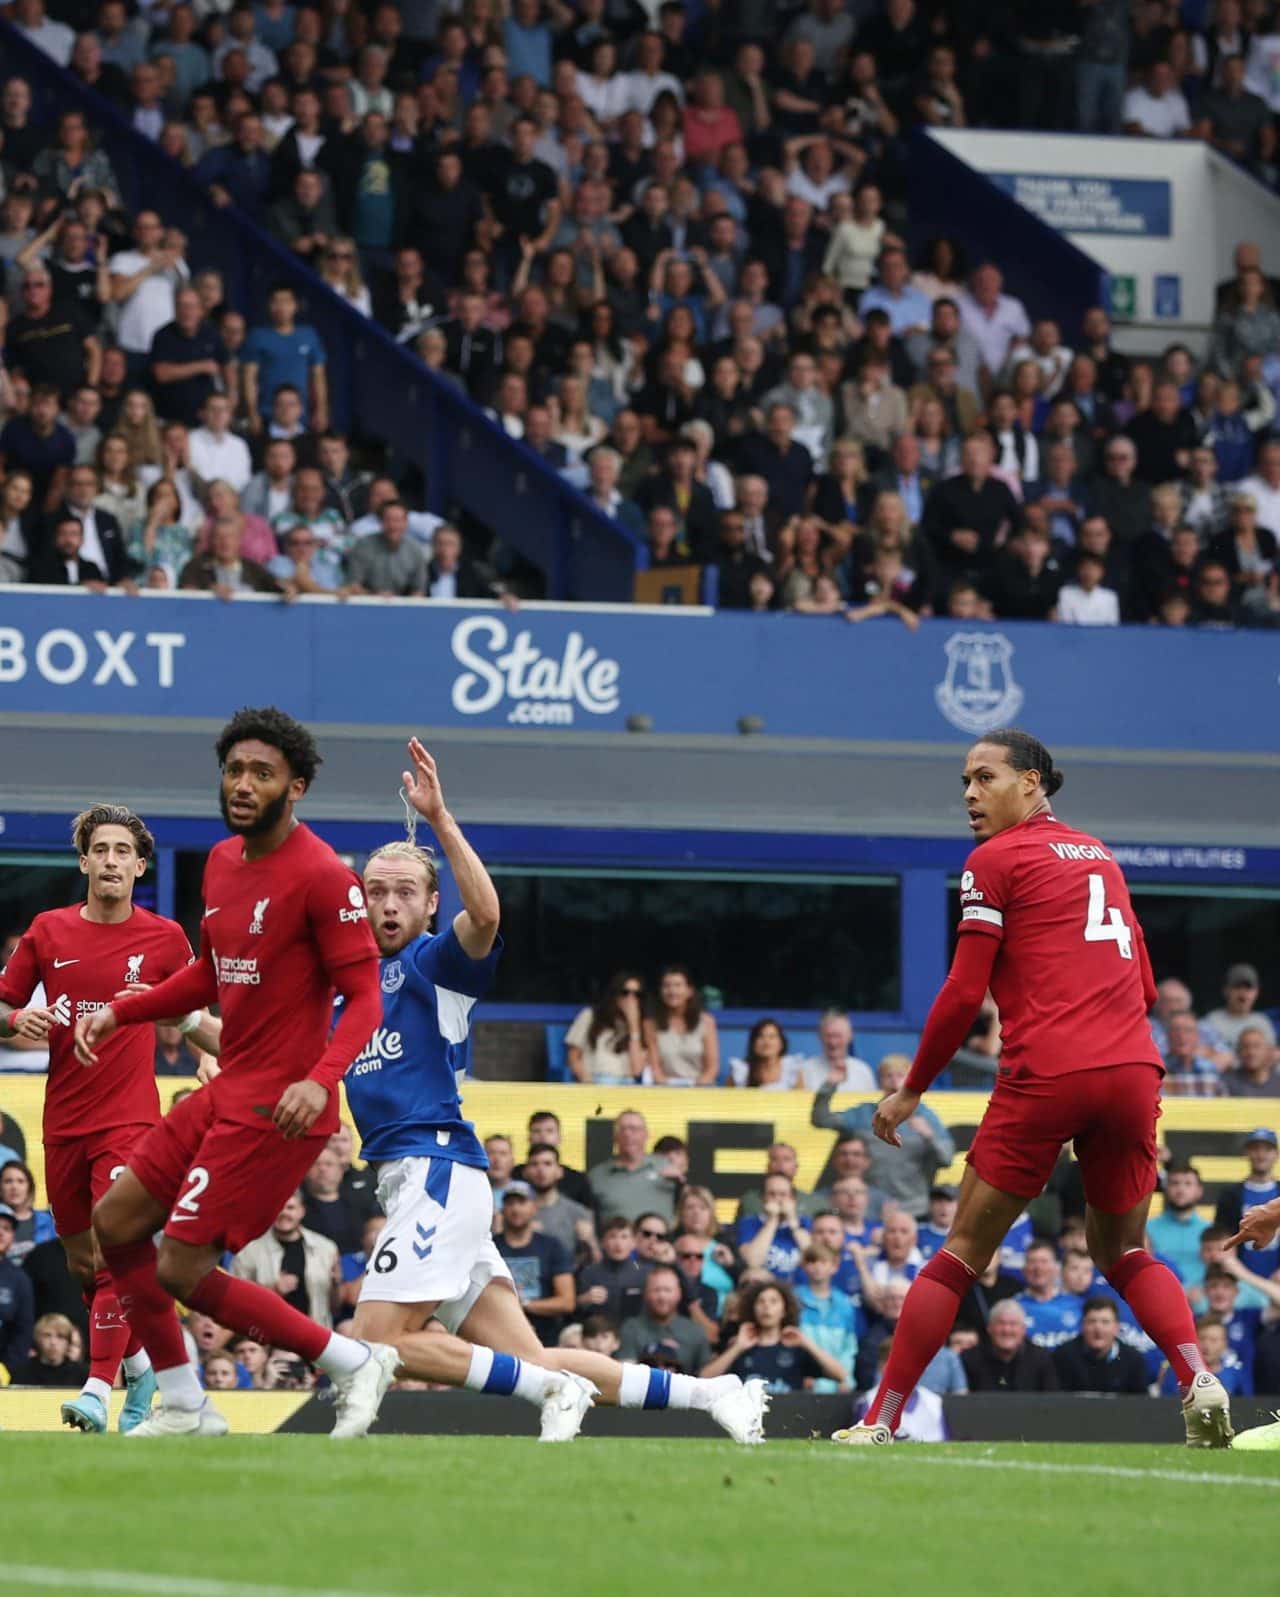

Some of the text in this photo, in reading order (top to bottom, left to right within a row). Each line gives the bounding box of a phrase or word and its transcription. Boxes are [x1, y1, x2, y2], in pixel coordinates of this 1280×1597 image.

[451, 615, 621, 715] Stake
[507, 701, 574, 726] .com
[1049, 842, 1112, 861] VIRGIL
[1084, 873, 1133, 960] 4
[354, 1026, 404, 1063] ake
[352, 1057, 383, 1077] .com
[177, 1166, 210, 1213] 2
[366, 1236, 398, 1275] 6
